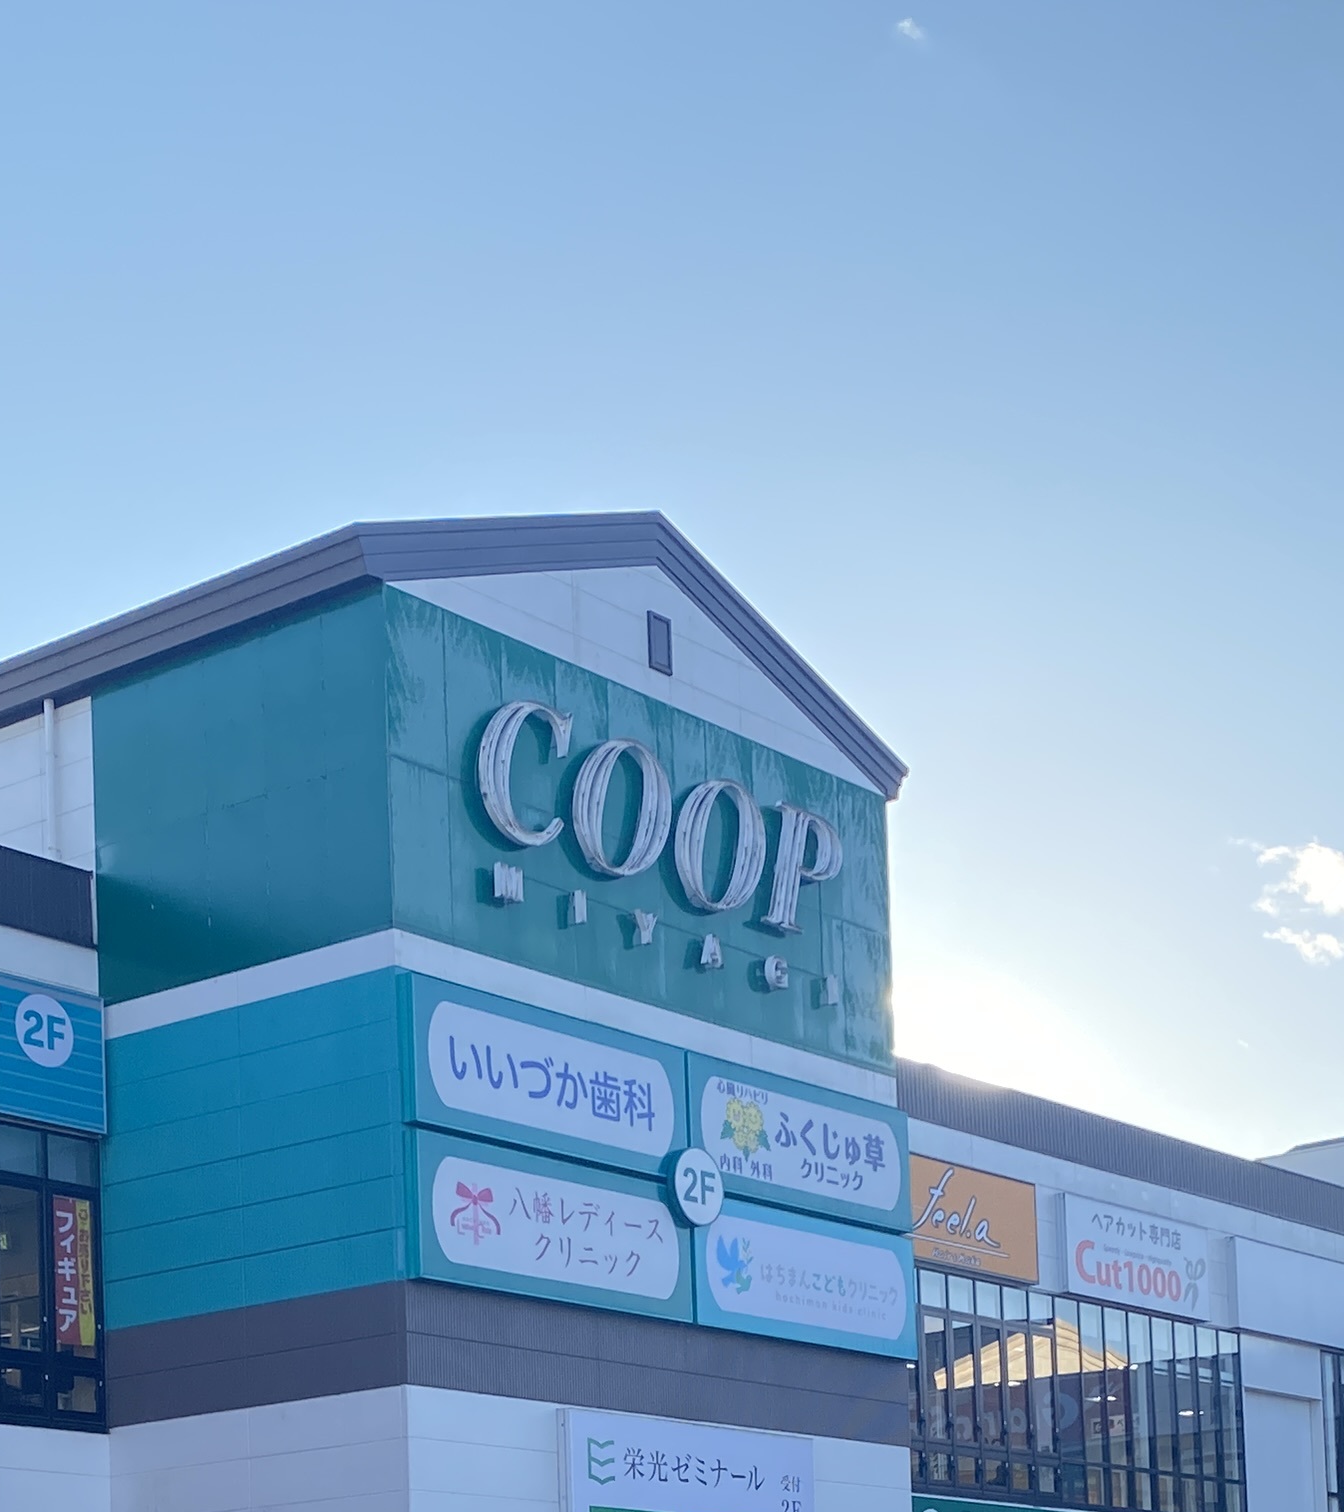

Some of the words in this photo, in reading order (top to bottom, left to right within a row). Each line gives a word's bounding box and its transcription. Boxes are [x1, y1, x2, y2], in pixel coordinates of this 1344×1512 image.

[477, 700, 843, 933] COOP
[493, 862, 838, 1005] MIYAGI
[23, 1008, 67, 1050] 2F
[449, 1036, 655, 1132] いいづか歯科
[775, 1112, 885, 1172] ふくじゅ草
[682, 1167, 715, 1206] 2F
[720, 1153, 742, 1174] 内科
[750, 1160, 773, 1181] 外科
[801, 1159, 864, 1191] クリニック
[509, 1187, 663, 1243] 八幡レディース
[1092, 1213, 1181, 1251] ヘアカット専門店
[56, 1210, 78, 1332] フィギュア
[536, 1233, 641, 1277] クリニック
[1075, 1239, 1182, 1302] Cut1000
[760, 1263, 898, 1305] はちまんこどもクリニック
[623, 1447, 765, 1491] 栄光ゼミナール
[780, 1474, 801, 1493] 受付
